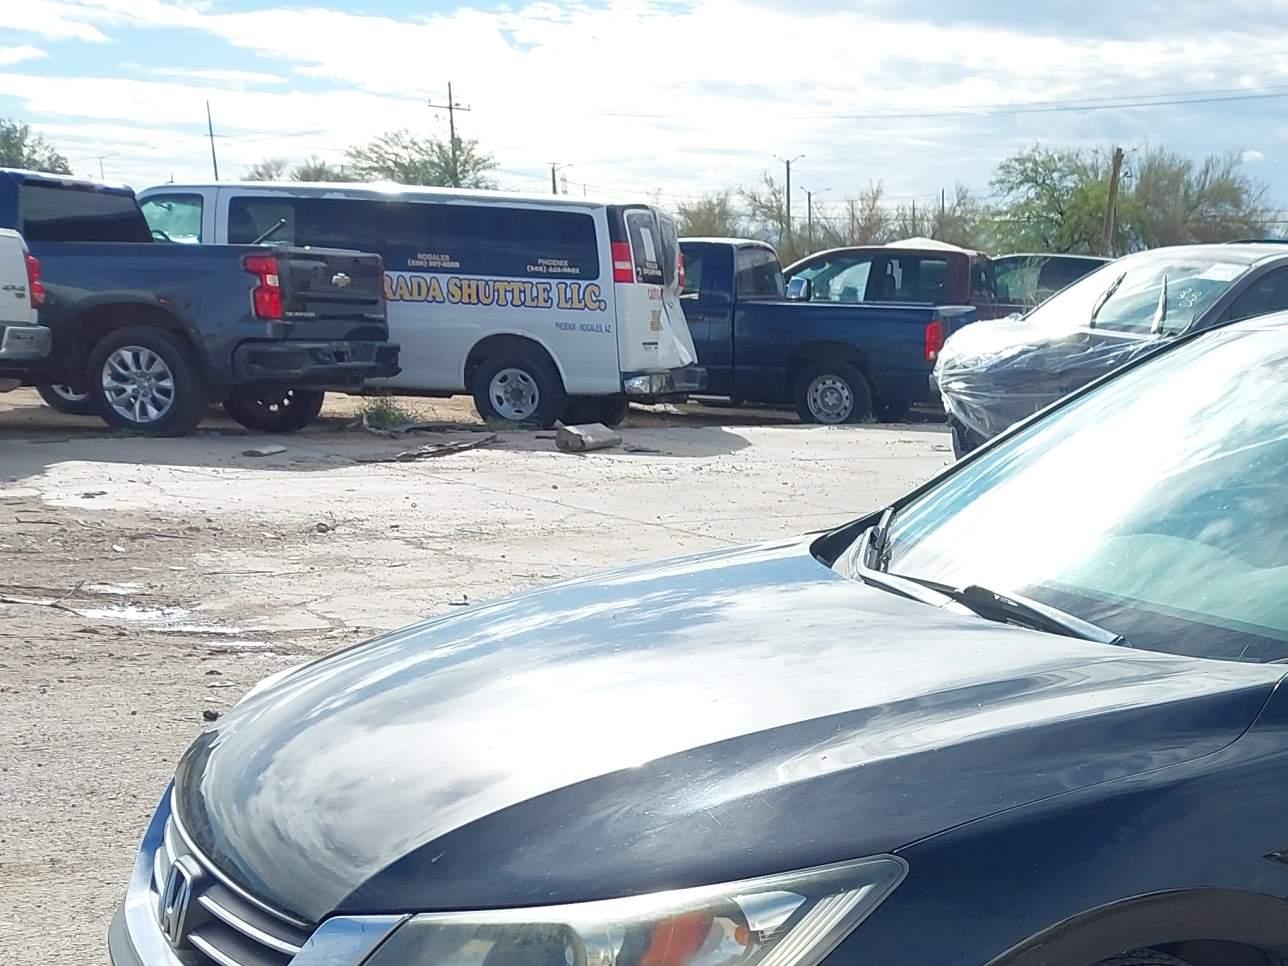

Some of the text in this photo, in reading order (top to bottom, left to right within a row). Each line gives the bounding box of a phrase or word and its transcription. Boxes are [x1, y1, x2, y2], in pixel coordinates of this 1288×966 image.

[537, 258, 569, 267] PHOENIX
[447, 276, 553, 308] SHUTTLE
[556, 282, 607, 312] LLC.
[555, 321, 576, 331] PHOENIX
